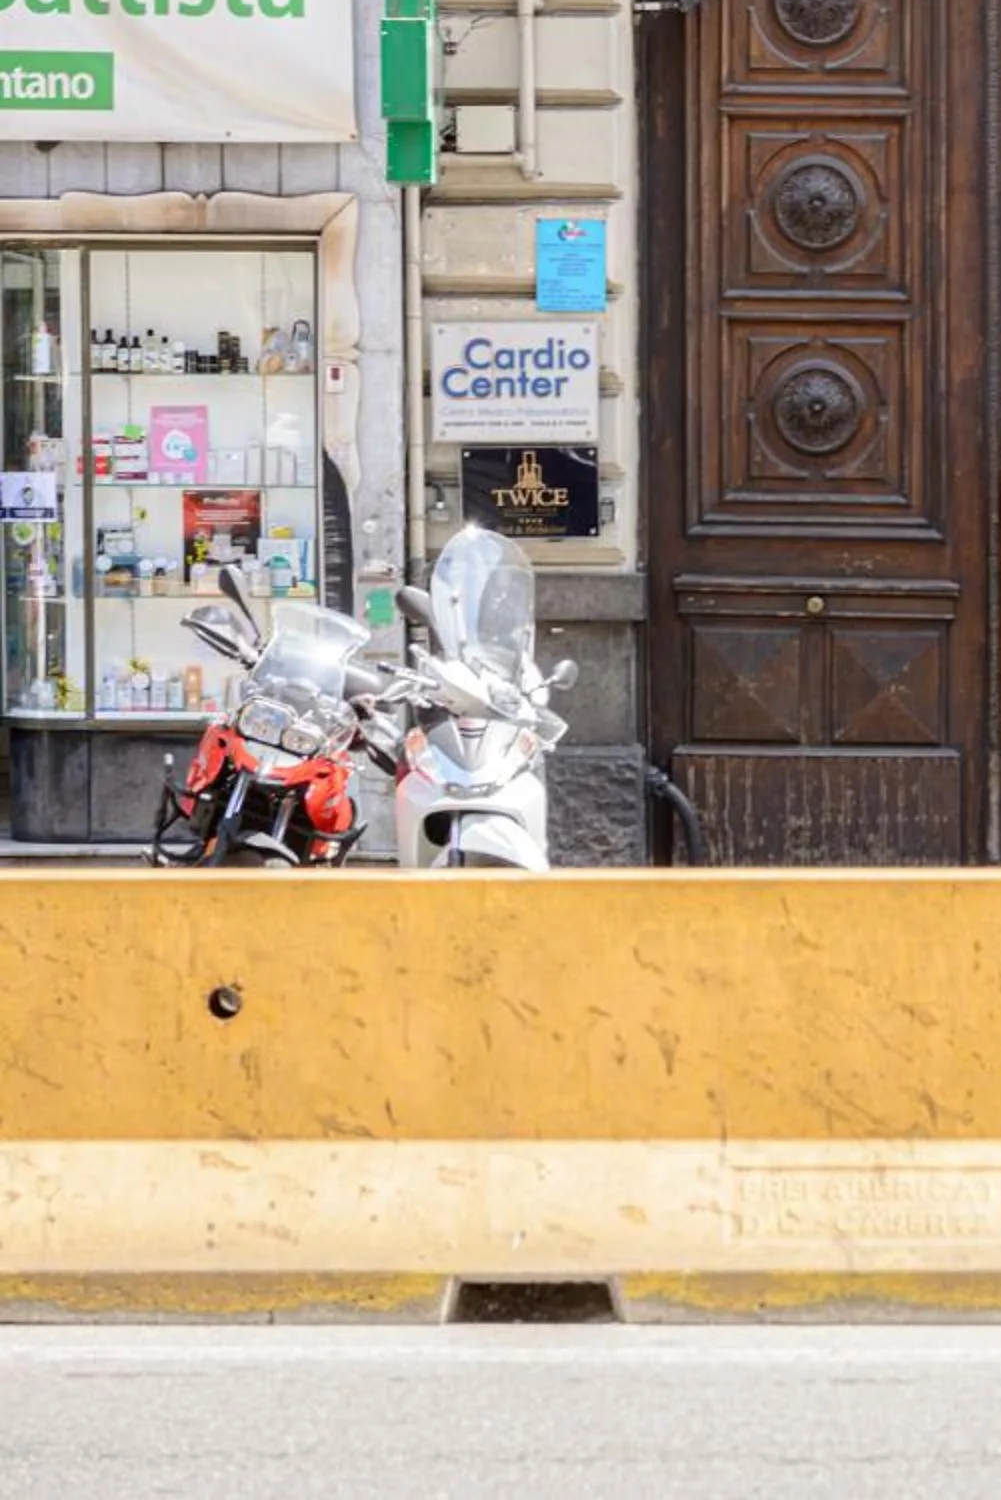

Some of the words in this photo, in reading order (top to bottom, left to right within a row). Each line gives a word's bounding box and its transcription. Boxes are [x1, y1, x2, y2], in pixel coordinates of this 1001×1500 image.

[464, 337, 590, 369] Cardio
[441, 367, 568, 398] Center
[490, 488, 569, 507] TWICE
